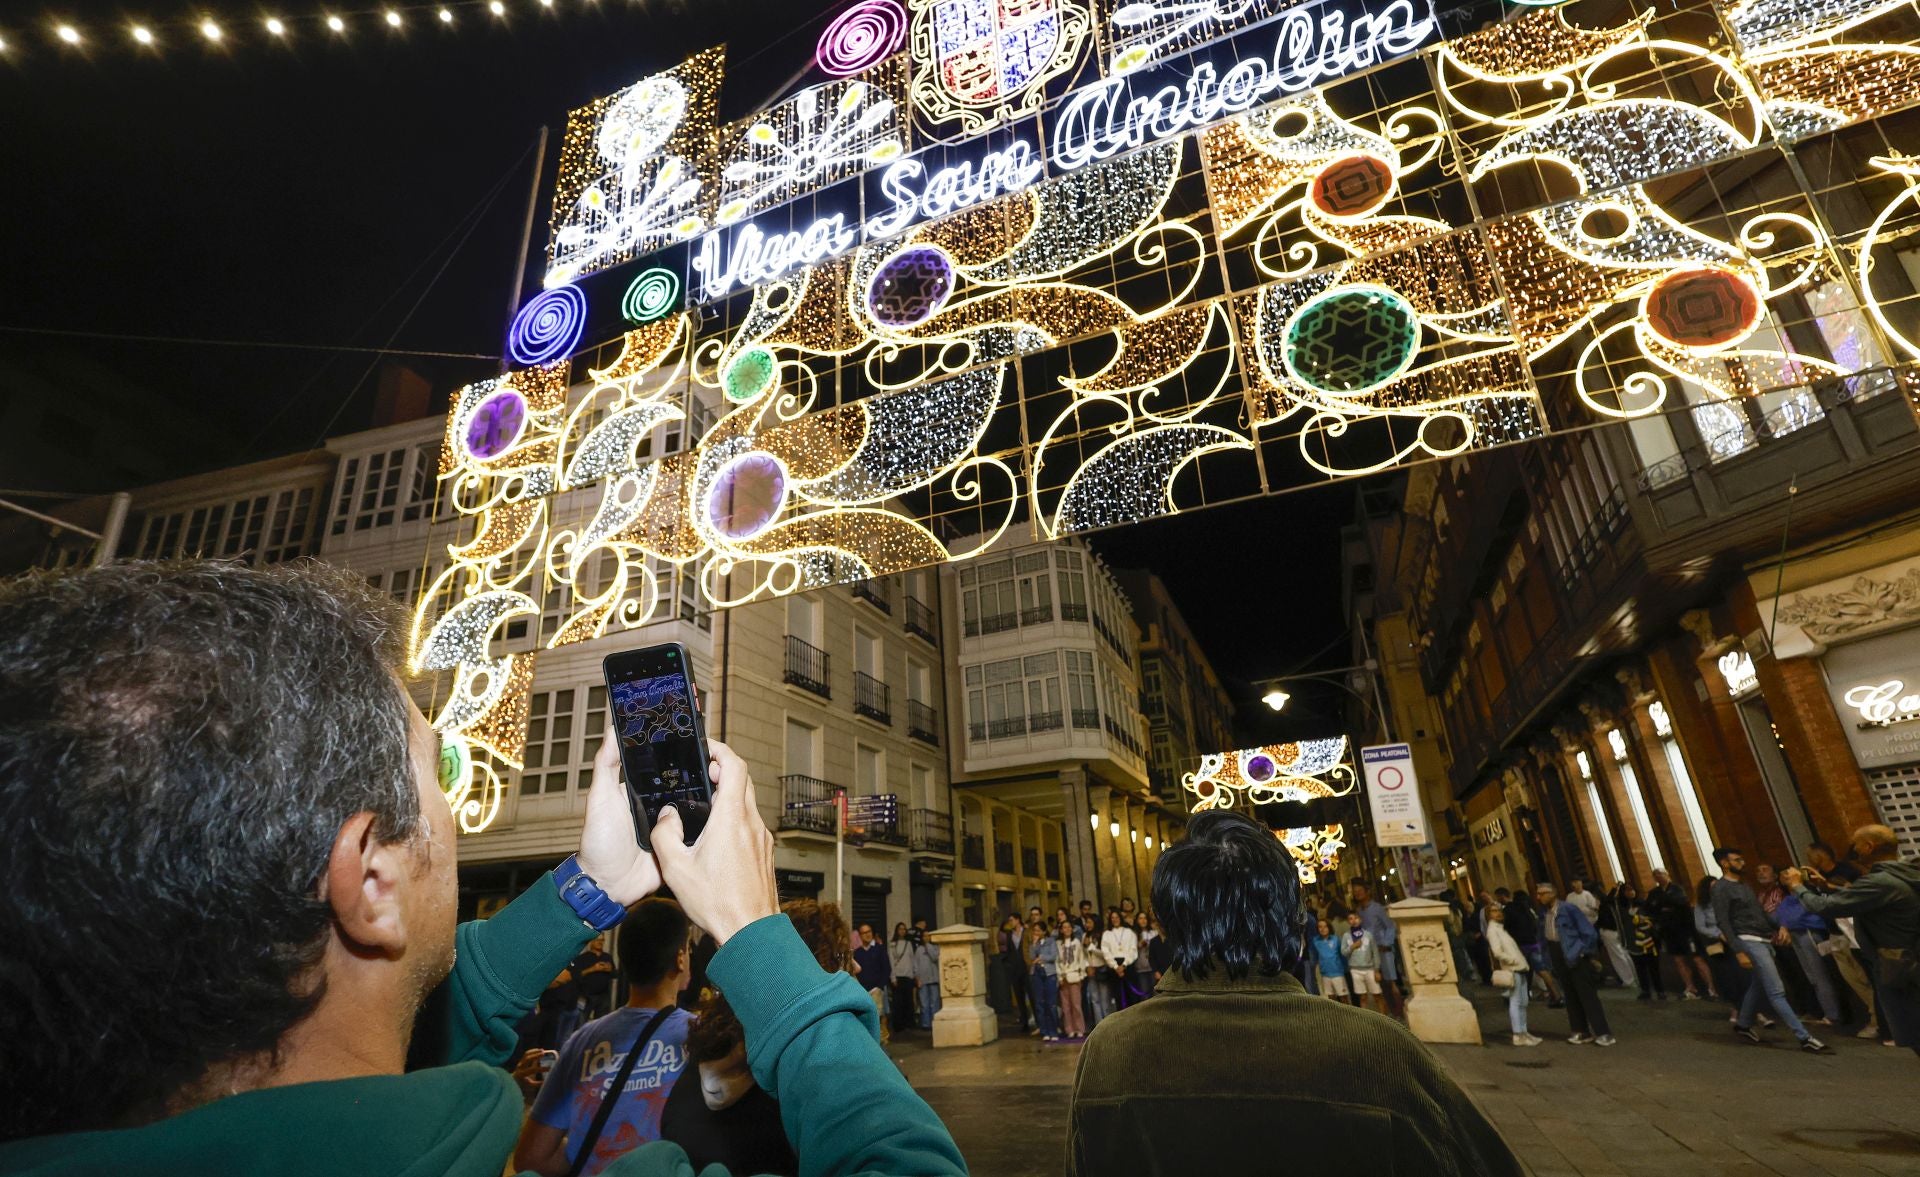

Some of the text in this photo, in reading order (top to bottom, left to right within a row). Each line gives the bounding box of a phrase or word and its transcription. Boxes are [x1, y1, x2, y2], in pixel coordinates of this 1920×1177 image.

[692, 212, 854, 297] Viva
[866, 140, 1044, 239] San
[1364, 747, 1409, 760] ZONA PEATONAL
[580, 1041, 630, 1082] Laz
[603, 1067, 662, 1093] Smmer
